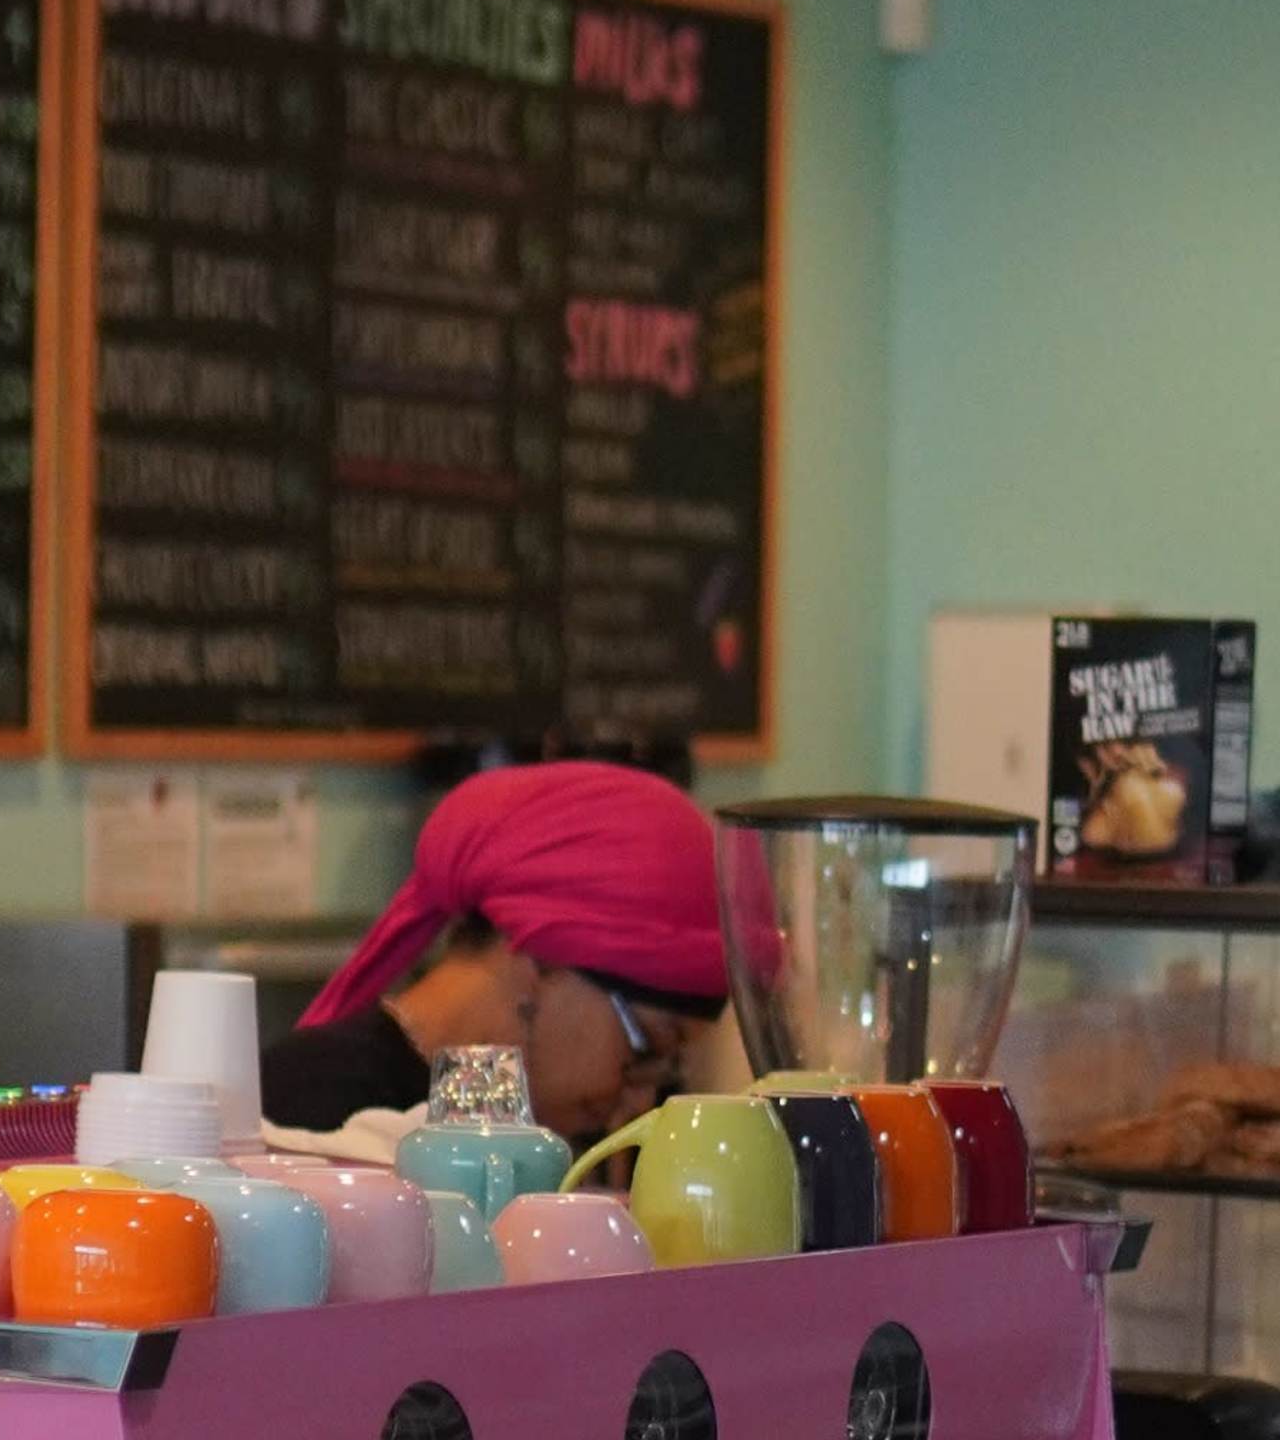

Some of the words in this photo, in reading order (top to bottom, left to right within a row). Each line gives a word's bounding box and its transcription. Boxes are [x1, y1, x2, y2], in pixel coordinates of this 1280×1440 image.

[573, 8, 706, 110] MILKS
[564, 297, 704, 398] SYRUPS
[1069, 660, 1156, 697] SUGAR
[1085, 686, 1117, 722] IN
[1122, 681, 1177, 720] THE
[1082, 709, 1138, 744] RAW
